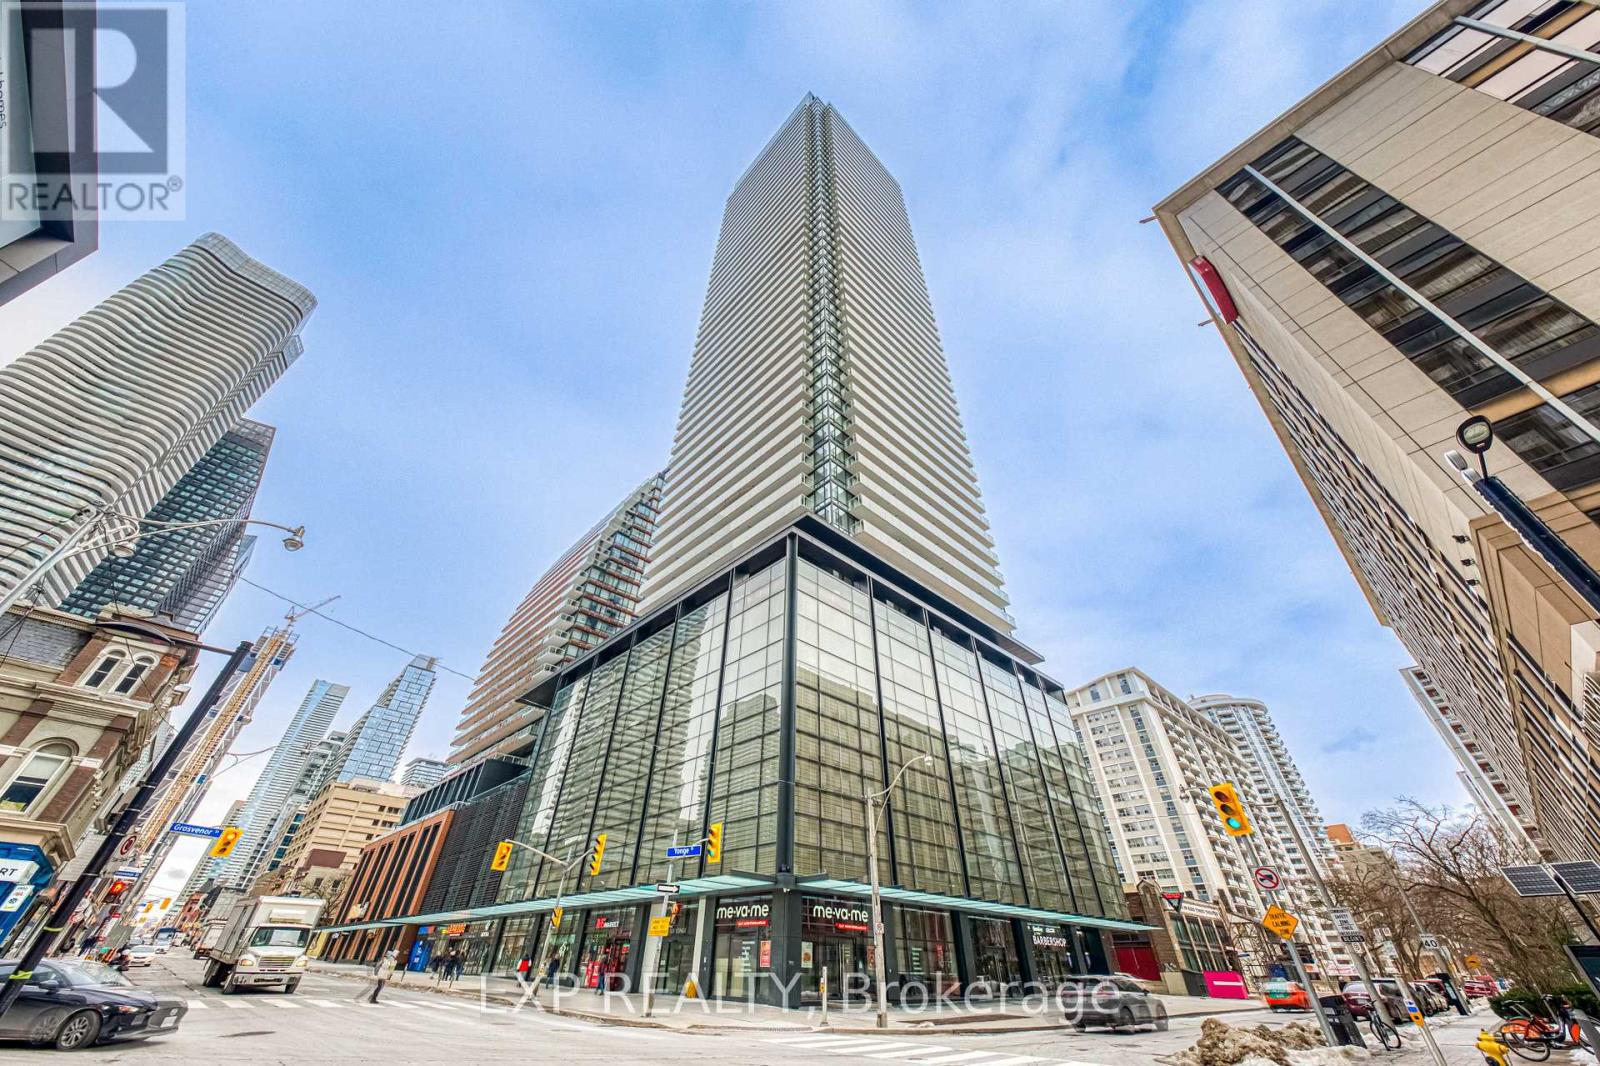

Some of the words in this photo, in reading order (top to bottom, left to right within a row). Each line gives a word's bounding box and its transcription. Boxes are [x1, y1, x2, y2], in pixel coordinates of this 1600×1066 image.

[173, 823, 213, 835] Grosvenor
[1032, 935, 1067, 947] BARBERSHOP
[1425, 940, 1438, 948] 40
